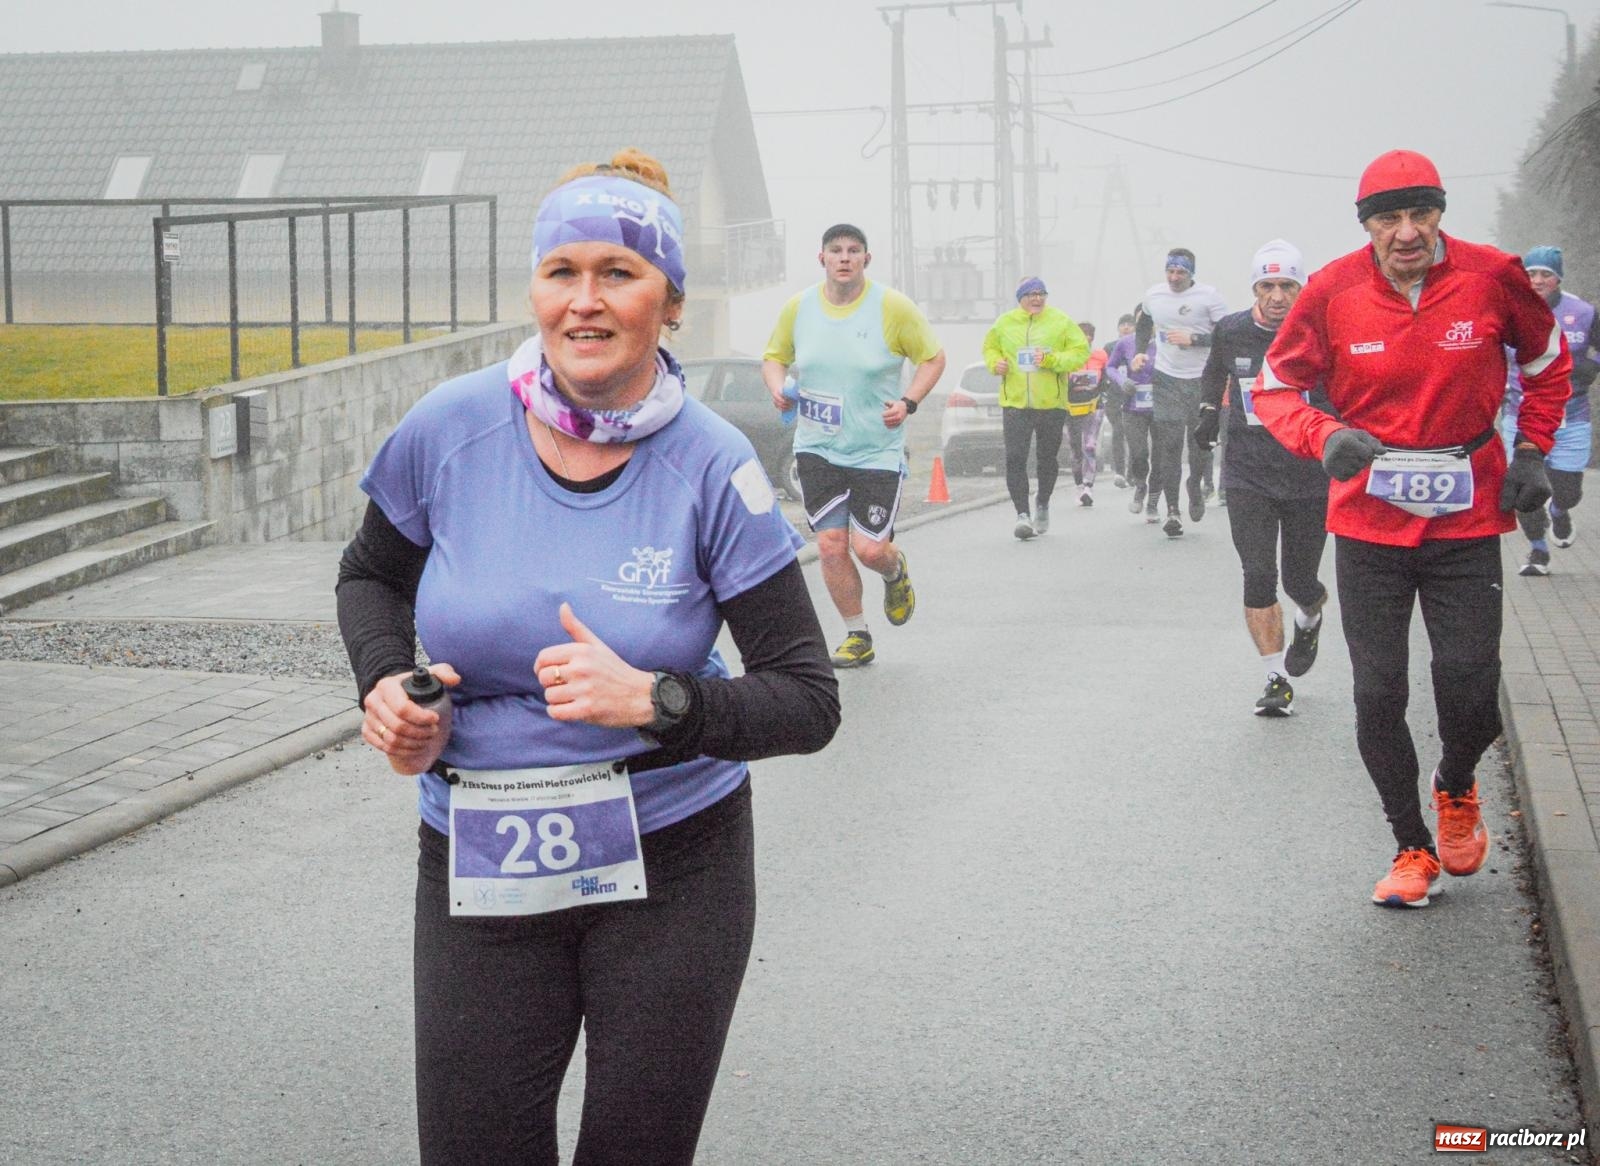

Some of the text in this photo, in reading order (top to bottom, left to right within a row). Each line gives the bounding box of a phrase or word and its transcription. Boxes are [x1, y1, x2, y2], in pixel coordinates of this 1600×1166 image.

[598, 192, 645, 215] EKO
[1445, 327, 1474, 342] Gryf
[1564, 331, 1585, 343] RS
[805, 400, 833, 424] 114
[1388, 473, 1456, 502] 189
[618, 560, 673, 590] Gryf
[504, 783, 516, 793] po
[517, 780, 544, 791] Ziemi
[544, 769, 612, 789] Piotrowickiej
[496, 812, 581, 874] 28
